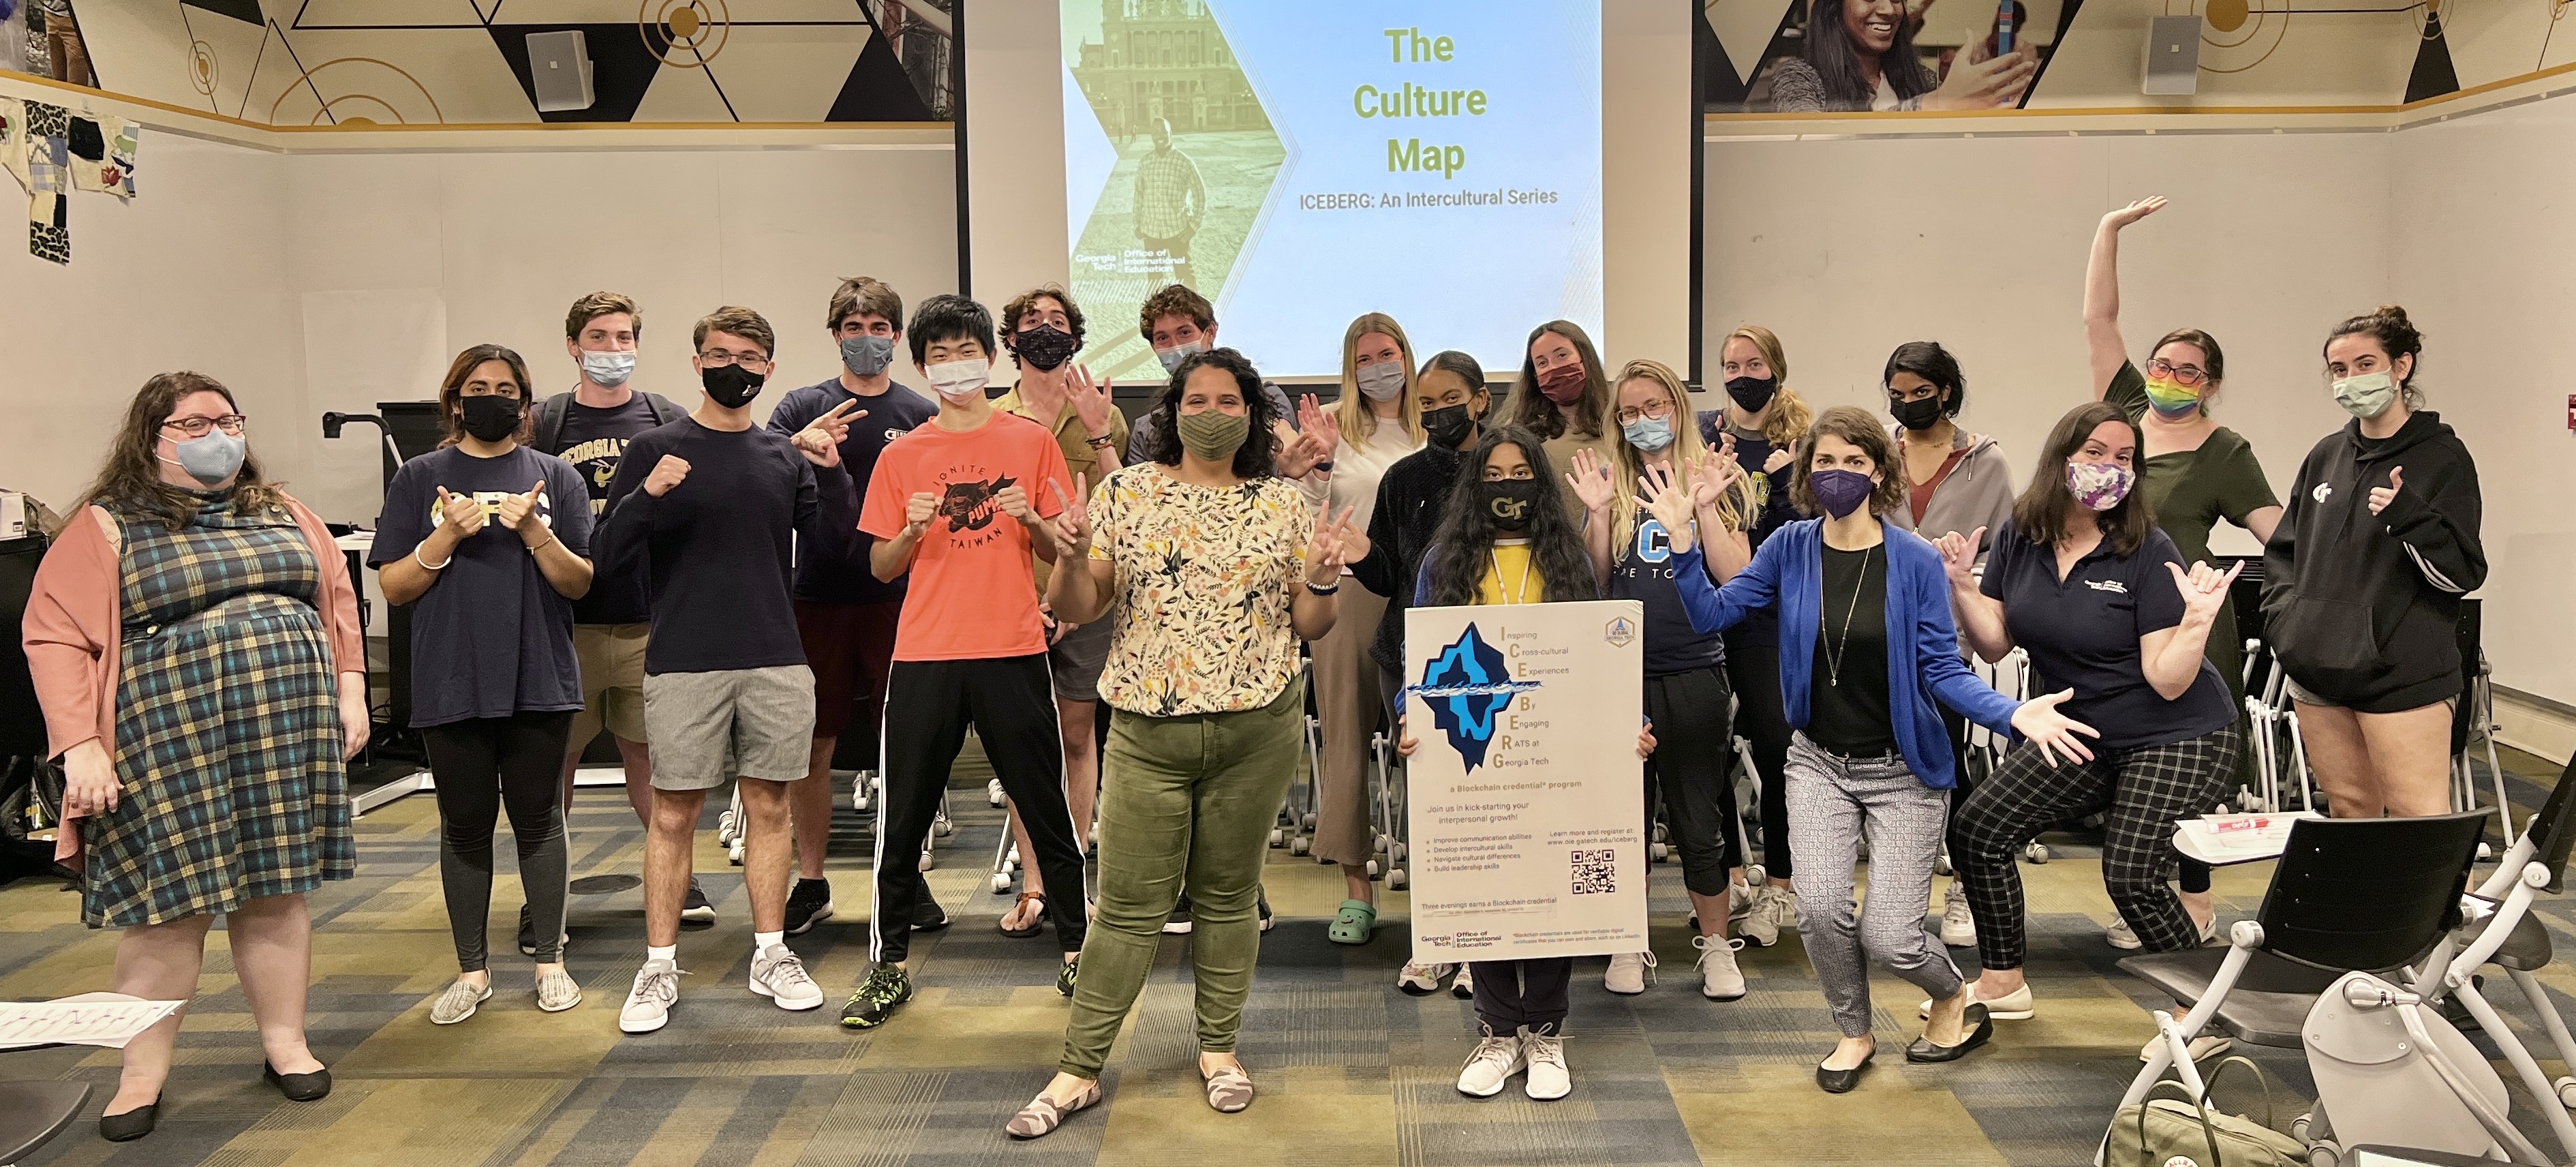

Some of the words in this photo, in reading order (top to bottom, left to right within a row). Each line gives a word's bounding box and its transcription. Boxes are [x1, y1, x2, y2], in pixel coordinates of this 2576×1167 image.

[1384, 27, 1454, 63] The
[1354, 82, 1486, 118] Culture
[1387, 138, 1465, 179] Map
[1300, 194, 1375, 209] ICEBERG:
[1380, 193, 1400, 207] An
[1407, 189, 1502, 207] Intercultural
[1507, 188, 1558, 204] Series
[1075, 254, 1116, 263] Georgia
[1124, 257, 1185, 265] International
[1093, 262, 1116, 271] Tech
[1124, 264, 1174, 273] Education
[932, 465, 985, 486] IGNITE
[968, 497, 1003, 524] PUM
[1491, 496, 1527, 520] GT
[951, 528, 1002, 549] TAIWAN
[1458, 784, 1501, 792] Blockchain
[1549, 780, 1582, 789] program
[1512, 802, 1529, 810] your
[1439, 815, 1488, 825] interpersonal
[1490, 814, 1518, 823] growth!
[1460, 834, 1507, 843] communication
[1434, 845, 1458, 853] Develop
[1441, 902, 1467, 910] evenings
